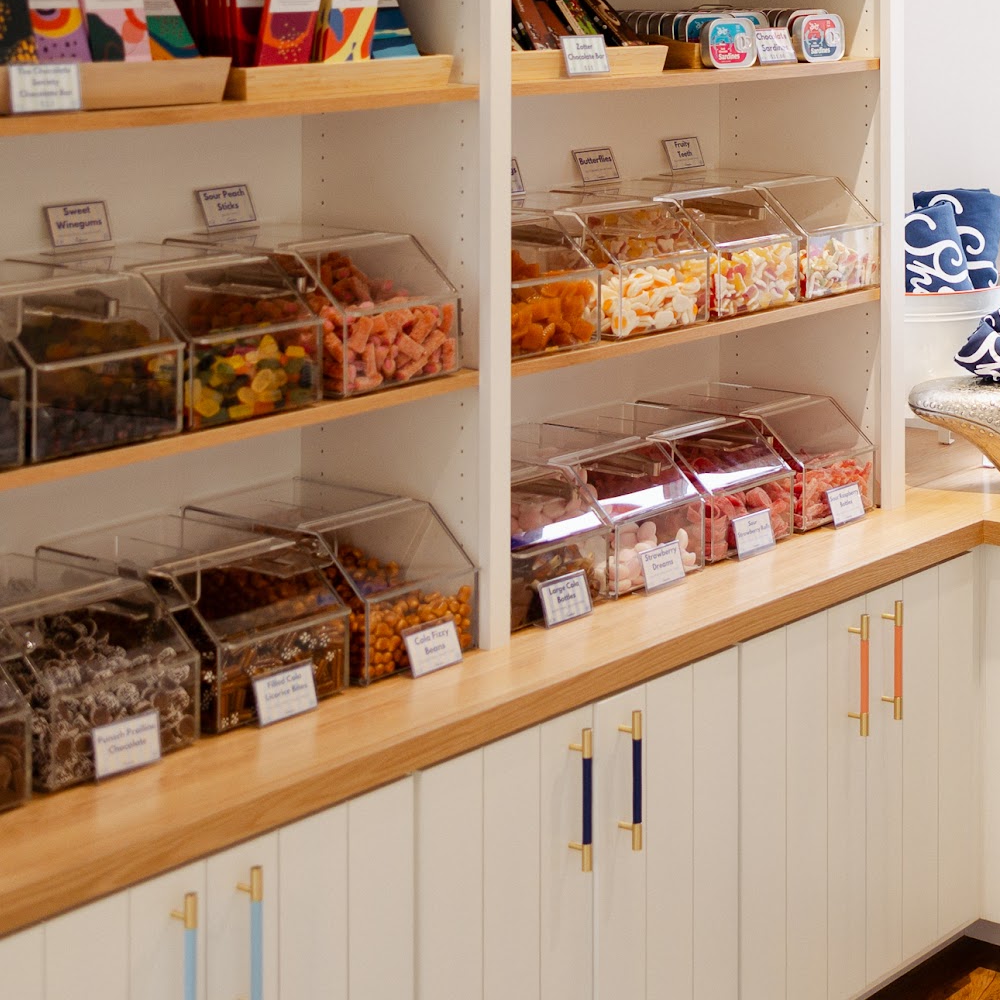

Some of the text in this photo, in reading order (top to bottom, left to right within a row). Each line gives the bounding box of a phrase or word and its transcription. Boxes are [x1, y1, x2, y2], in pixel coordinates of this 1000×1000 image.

[595, 52, 605, 60] Bar
[811, 47, 831, 55] Sardines
[718, 53, 741, 61] Sardines
[674, 141, 691, 149] Fruity
[677, 150, 693, 159] Teeth
[579, 154, 613, 167] Butterflies
[203, 188, 245, 201] Sour Peach
[63, 206, 91, 216] Sweet
[217, 202, 240, 212] Sticks
[55, 219, 103, 230] Winegums
[747, 519, 758, 527] Sour
[737, 526, 761, 538] Strawberry
[644, 546, 677, 562] Strawberry
[652, 559, 674, 571] Dreams
[548, 583, 566, 596] Large
[556, 593, 577, 604] Bottles
[424, 643, 446, 656] Beans
[108, 737, 147, 754] Chocolate
